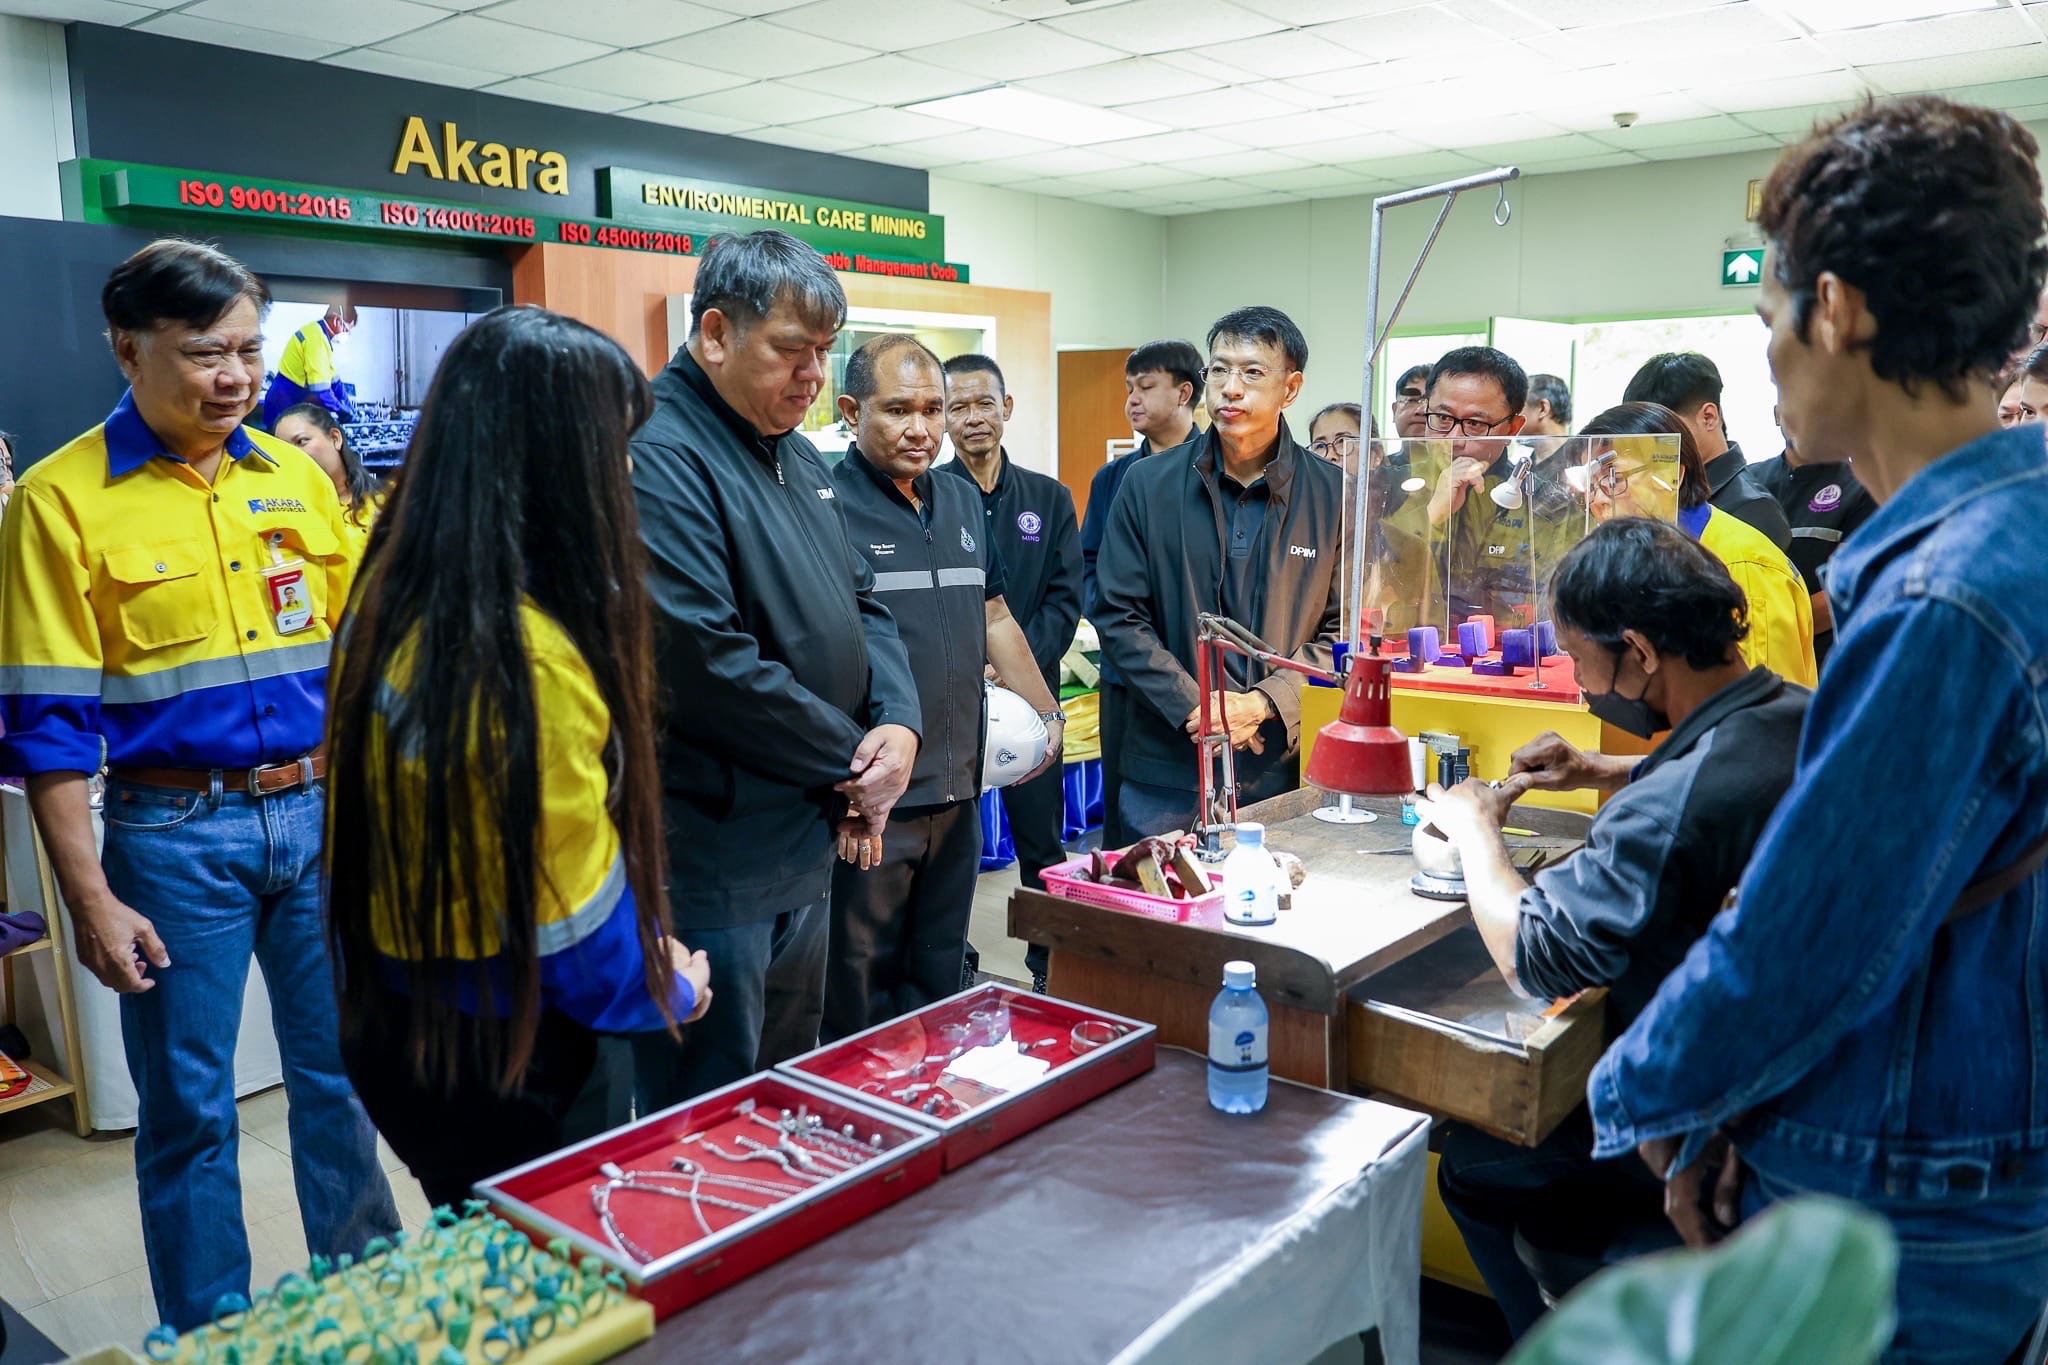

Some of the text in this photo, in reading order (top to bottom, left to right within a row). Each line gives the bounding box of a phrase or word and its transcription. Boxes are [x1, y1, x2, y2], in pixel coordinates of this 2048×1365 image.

[394, 116, 569, 196] Akara
[180, 180, 351, 220] ISO 9001:2015
[643, 182, 927, 240] ENVIRONMENTAL CARE MINING
[381, 202, 536, 238] ISO 14001:2015
[559, 222, 692, 254] ISO 45001:2018
[855, 254, 928, 277] Management
[930, 262, 959, 282] Code
[264, 498, 304, 508] AKARA
[1290, 545, 1316, 559] DPIM
